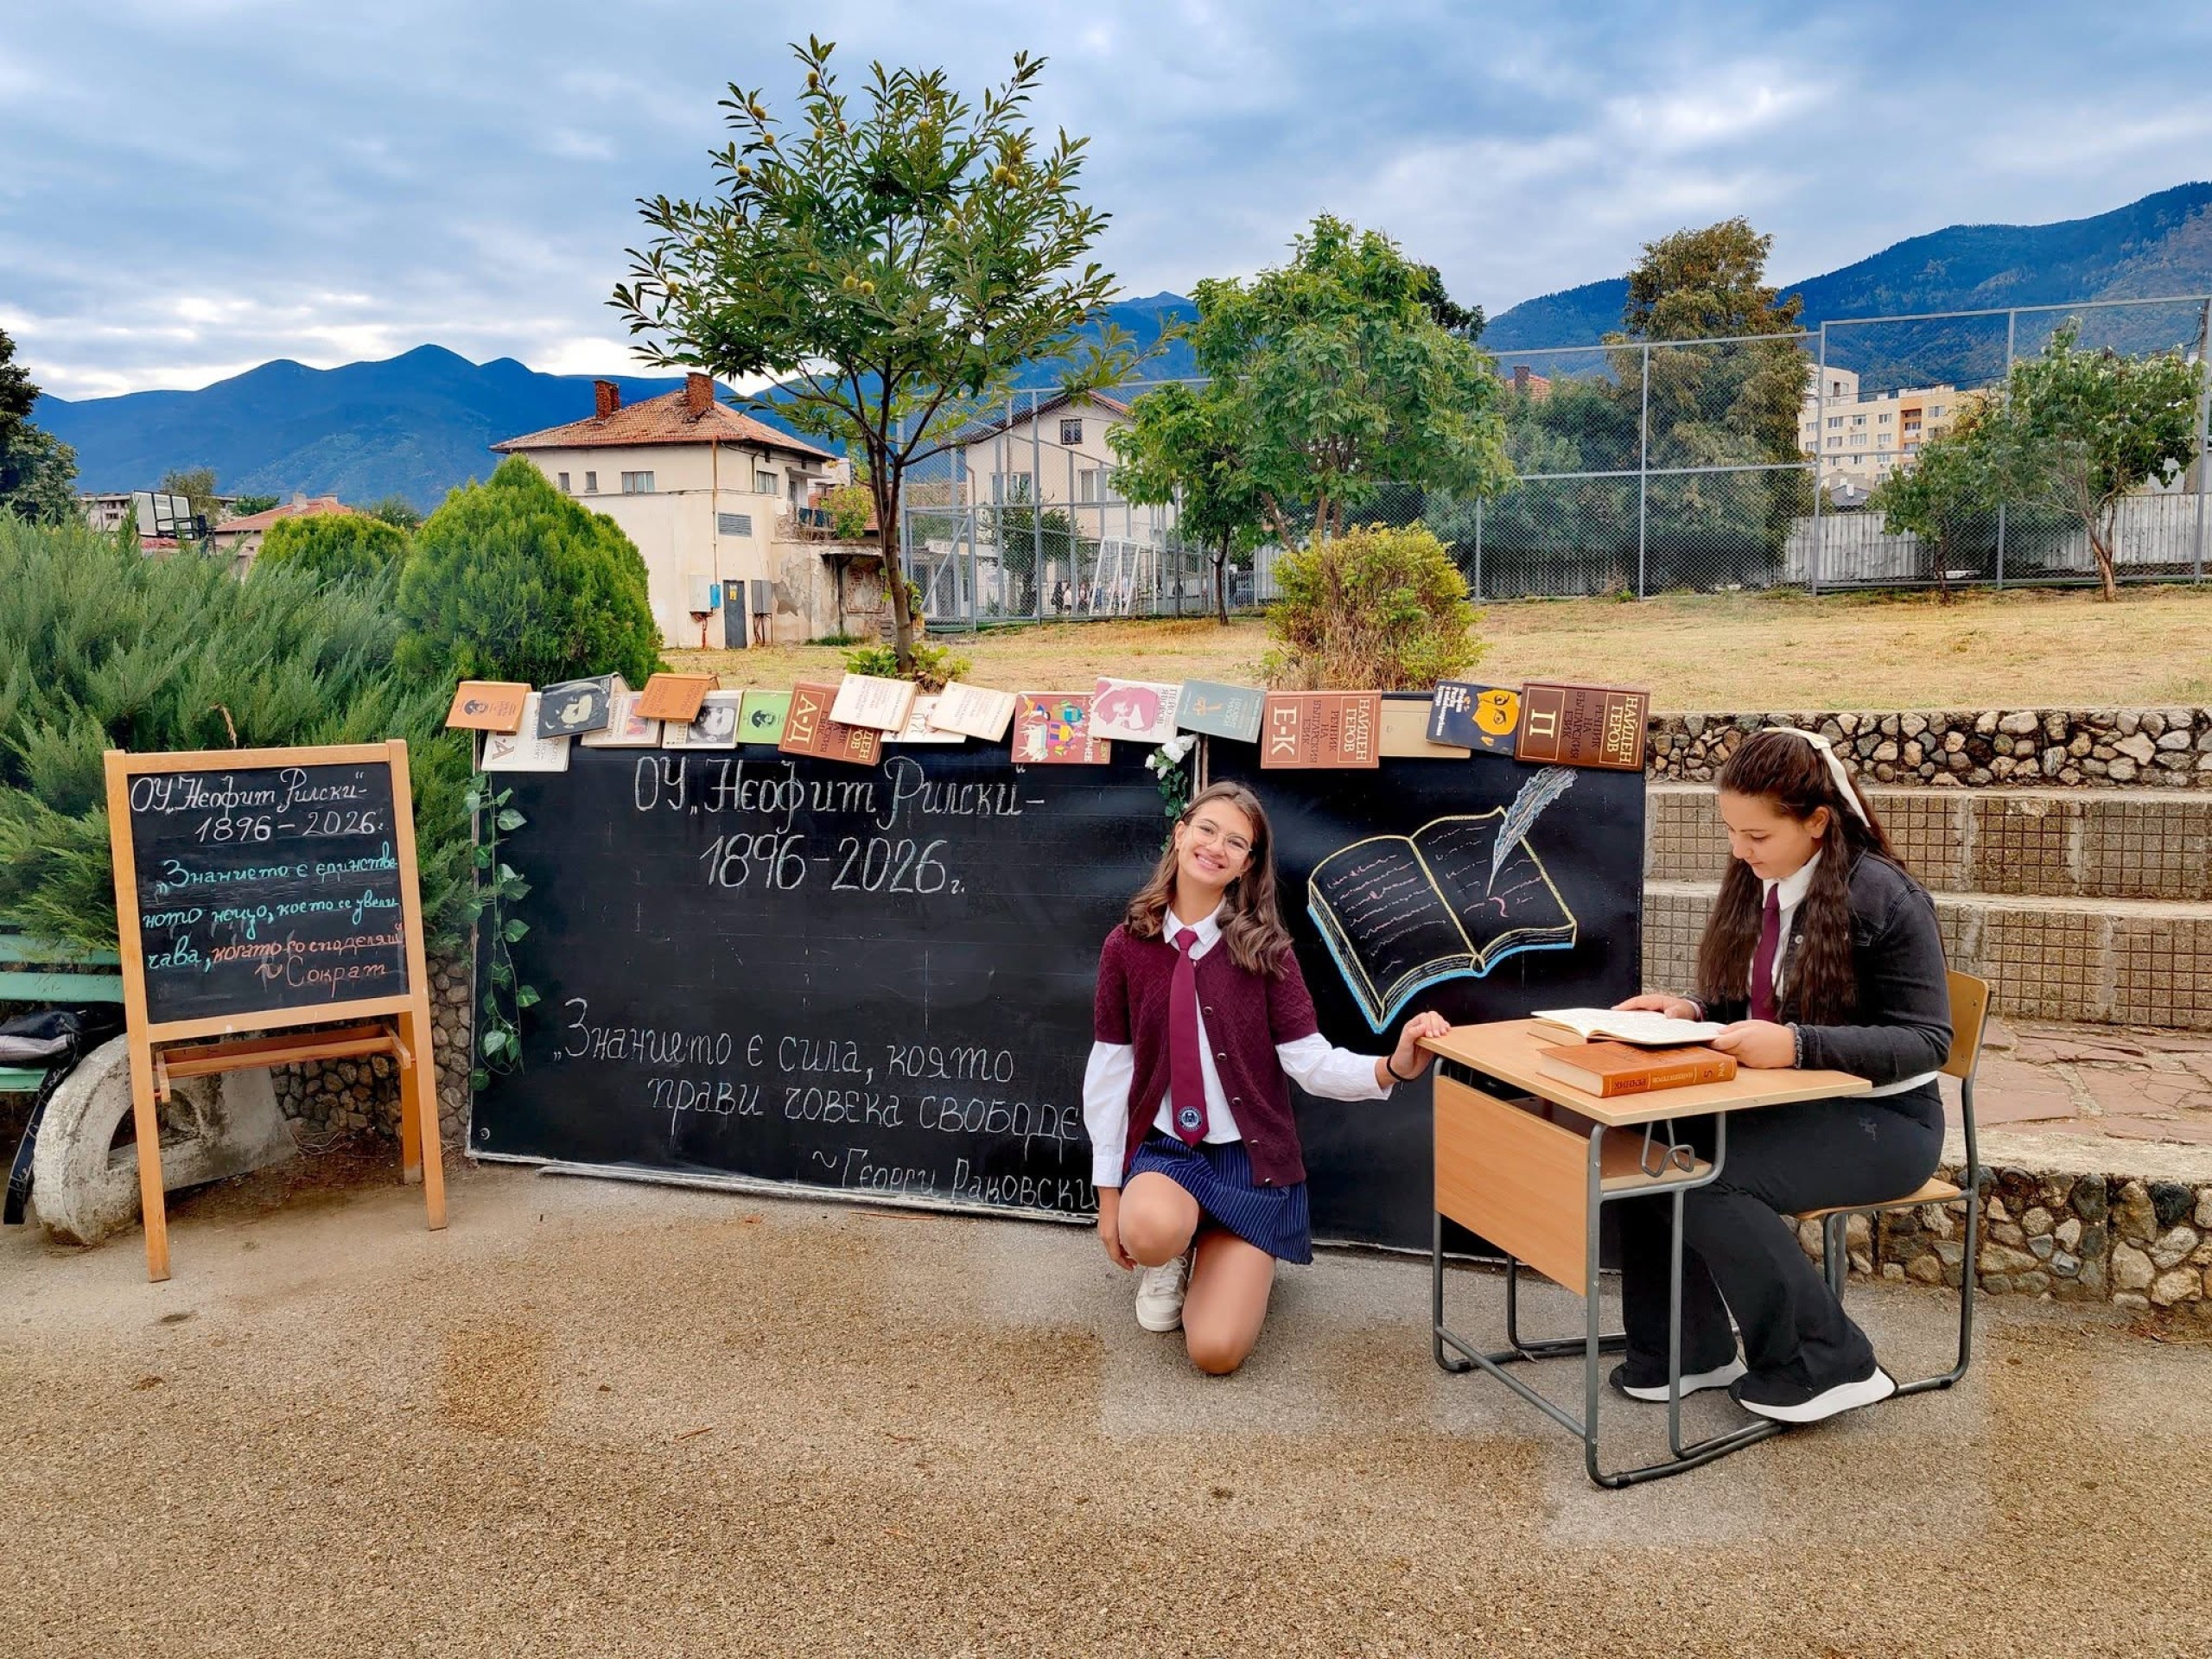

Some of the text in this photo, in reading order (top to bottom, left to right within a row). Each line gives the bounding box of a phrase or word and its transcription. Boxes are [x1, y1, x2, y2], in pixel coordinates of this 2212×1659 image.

[787, 693, 818, 744] А-Д
[1156, 689, 1168, 725] ЯВОРОВ
[1166, 690, 1178, 715] ПЕЙО
[1270, 706, 1297, 756] Е-К
[1301, 719, 1311, 745] ЕЗИК
[1309, 700, 1321, 764] БЪЛГАРСКИЯ
[1320, 724, 1329, 739] НА
[1329, 710, 1339, 753] РЕЧНИК
[1343, 708, 1357, 753] ГЕРОВ
[1355, 698, 1371, 761] НАЙДЕН
[1529, 709, 1557, 739] П
[1562, 710, 1573, 740] ЕЗИК
[1569, 691, 1586, 760] БЪЛГАРСКИЯ
[1582, 717, 1592, 733] НА
[1591, 704, 1605, 749] РЕЧНИК
[1606, 705, 1623, 753] ГЕРОВ
[1619, 696, 1638, 764] НАЙДЕН
[858, 729, 874, 760] ДЕН
[130, 777, 174, 812] ОУ
[634, 756, 687, 812] ОУ
[296, 864, 309, 878] е
[143, 908, 203, 929] ното
[276, 900, 334, 917] което
[338, 899, 353, 908] се
[212, 941, 283, 964] когато
[287, 940, 306, 953] го
[747, 1034, 764, 1067] е
[778, 1035, 873, 1085] сила,
[886, 1044, 1014, 1083] която
[1613, 1077, 1647, 1090] РЕЧНИК
[647, 1078, 765, 1136] прави
[918, 1095, 1079, 1165] свободе
